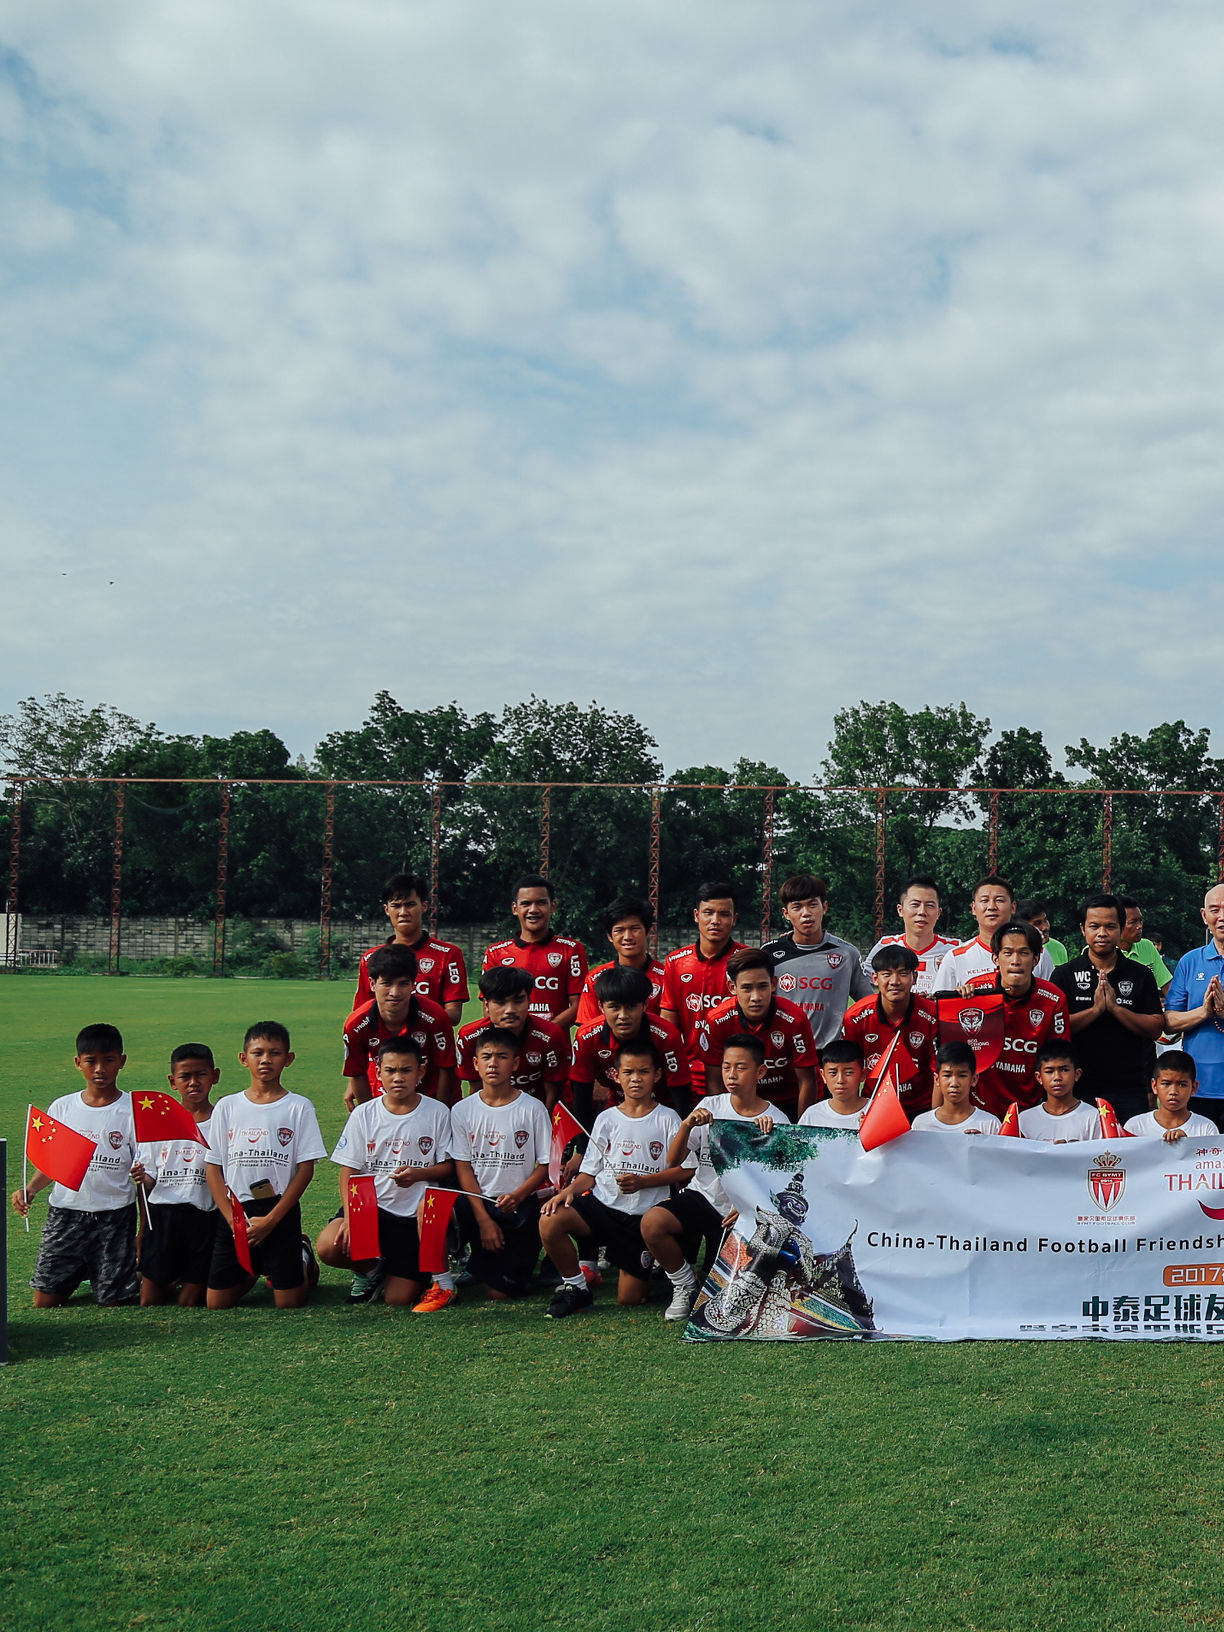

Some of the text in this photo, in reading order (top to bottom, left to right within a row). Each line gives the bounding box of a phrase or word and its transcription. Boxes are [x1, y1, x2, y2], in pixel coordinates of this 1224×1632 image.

[448, 962, 460, 984] LEO
[570, 955, 581, 977] LEO
[535, 976, 559, 990] CG
[799, 977, 833, 990] SCG
[1074, 971, 1091, 982] WC
[411, 982, 430, 995] CG
[1054, 1012, 1065, 1034] LEO
[434, 1031, 447, 1050] LEO
[792, 1033, 806, 1054] LEO
[1003, 1037, 1038, 1053] SCG
[664, 1050, 678, 1072] LEO
[764, 1057, 788, 1069] CG
[995, 1061, 1026, 1073] YAMAHA
[867, 1231, 1028, 1253] China-Thailand
[1038, 1238, 1127, 1253] Football
